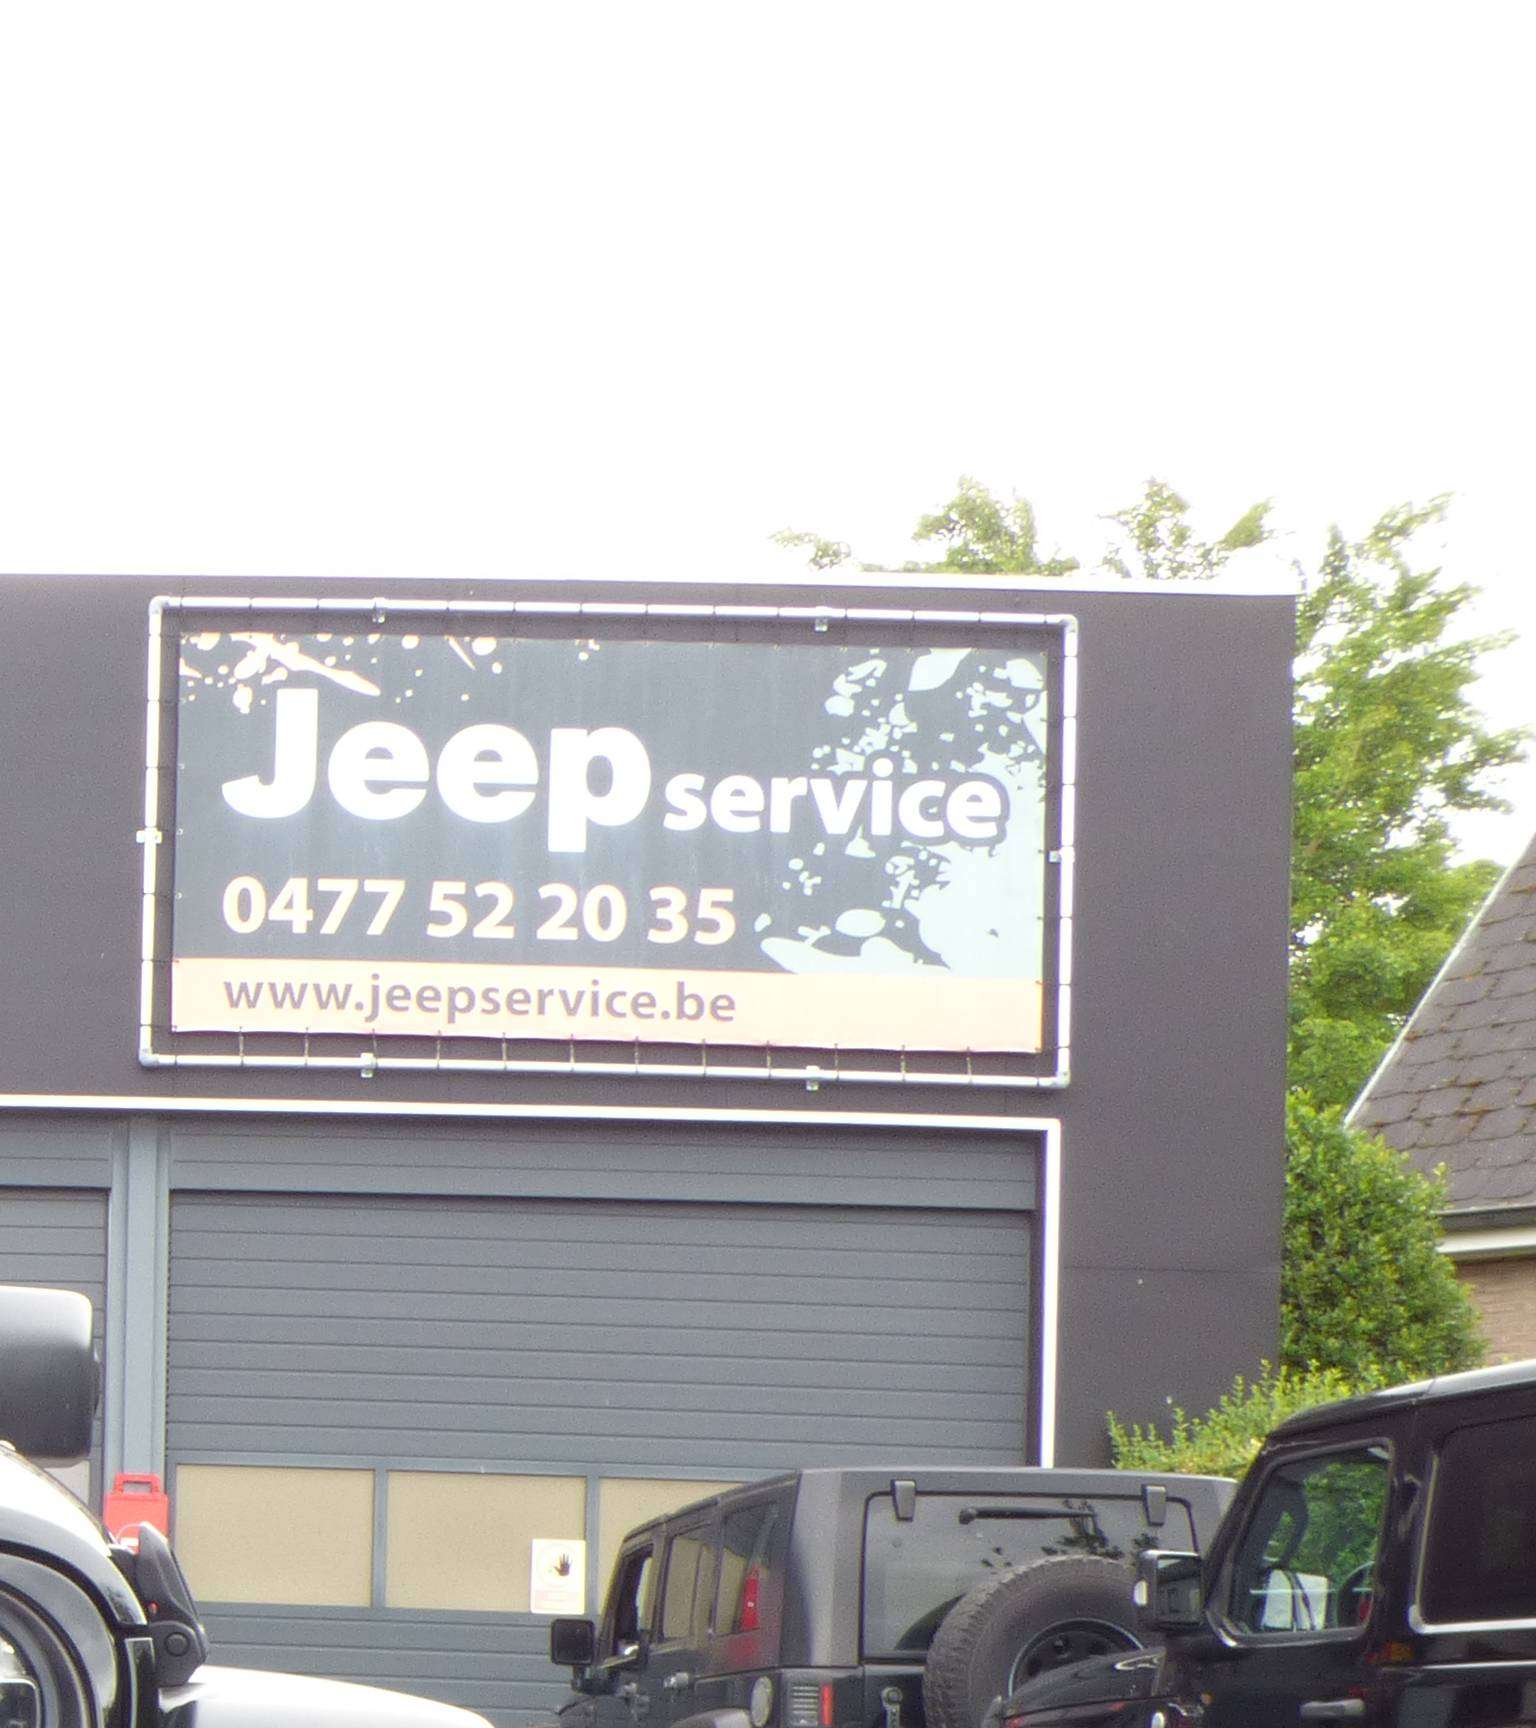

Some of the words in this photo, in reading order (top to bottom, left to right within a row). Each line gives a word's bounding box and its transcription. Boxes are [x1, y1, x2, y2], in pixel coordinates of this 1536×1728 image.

[221, 687, 652, 853] Jeep
[662, 757, 1003, 839] service
[221, 875, 407, 937] 0477
[425, 879, 518, 940] 52
[535, 884, 629, 943] 20
[645, 886, 737, 945] 35
[223, 973, 737, 1024] www.jeepservice.be
